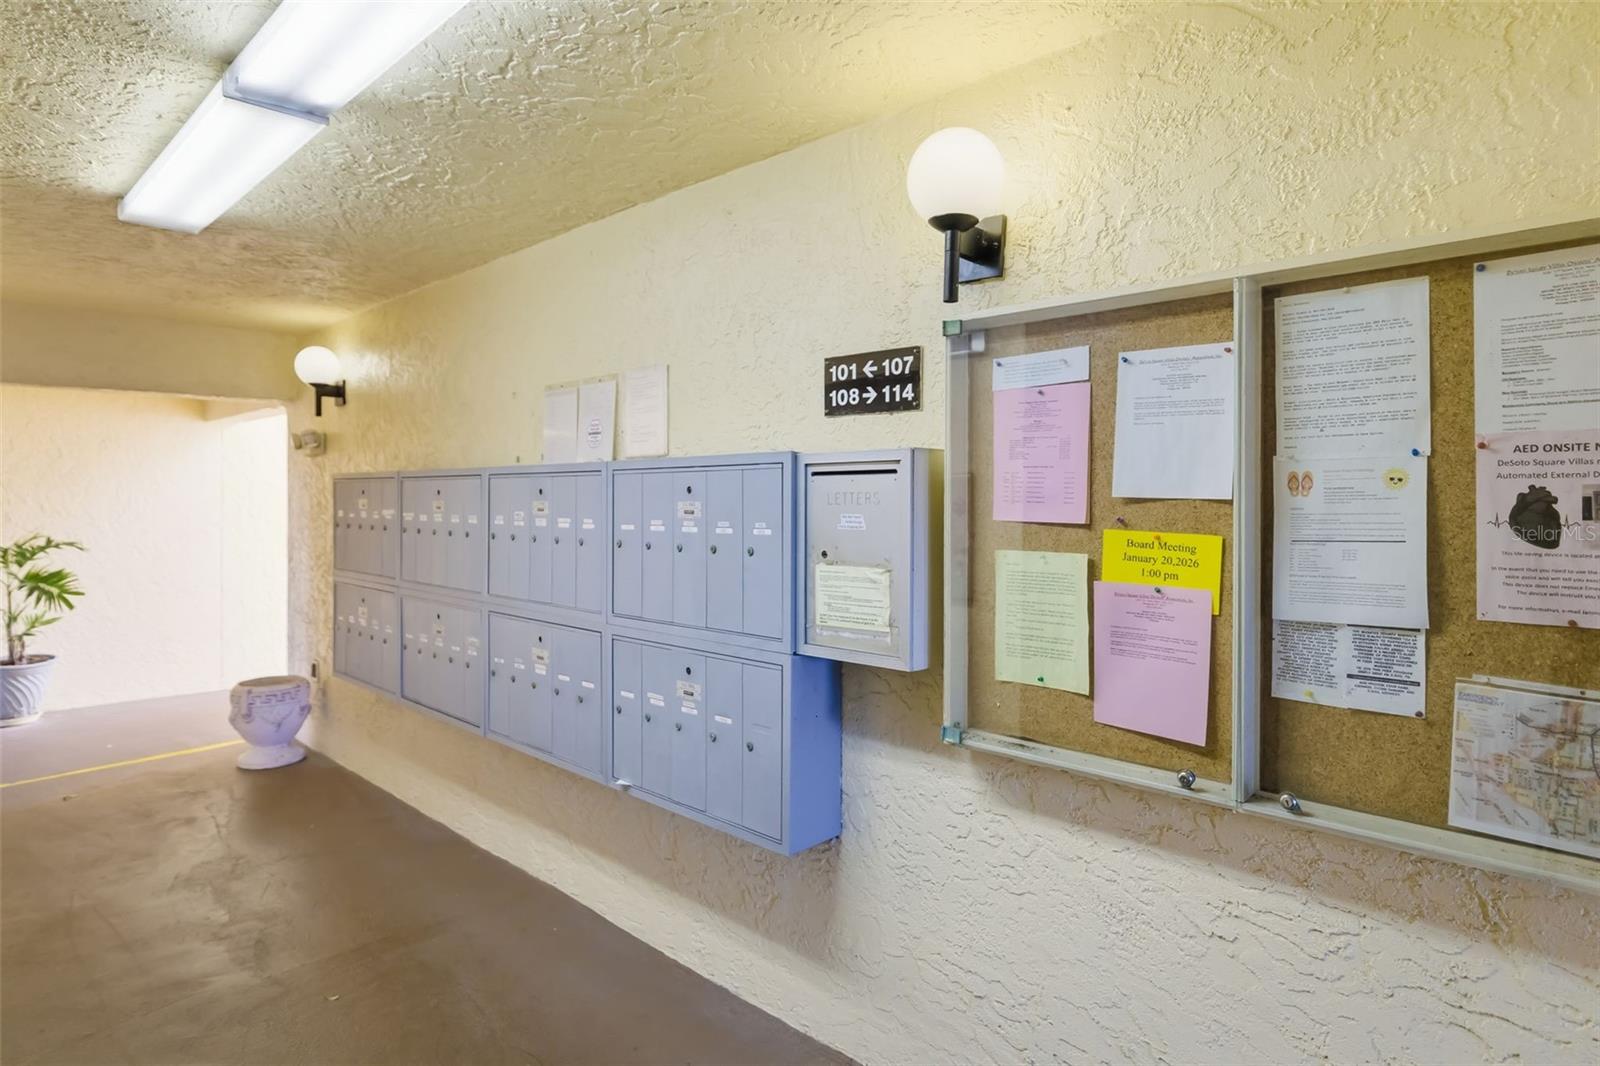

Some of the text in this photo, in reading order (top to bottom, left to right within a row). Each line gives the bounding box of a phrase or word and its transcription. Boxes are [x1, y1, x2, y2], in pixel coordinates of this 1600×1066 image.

[829, 355, 914, 382] 101 107
[829, 383, 915, 407] 108 114
[1513, 444, 1539, 454] AED
[1542, 442, 1591, 453] ONSITE
[1497, 459, 1531, 467] DeSoto
[1533, 458, 1566, 467] Square
[1496, 472, 1548, 480] Automated
[1550, 470, 1591, 479] External
[826, 491, 880, 506] LETTERS
[1126, 539, 1197, 555] Board Meeting
[1122, 552, 1158, 566] January
[1141, 568, 1179, 581] 1:00 pm
